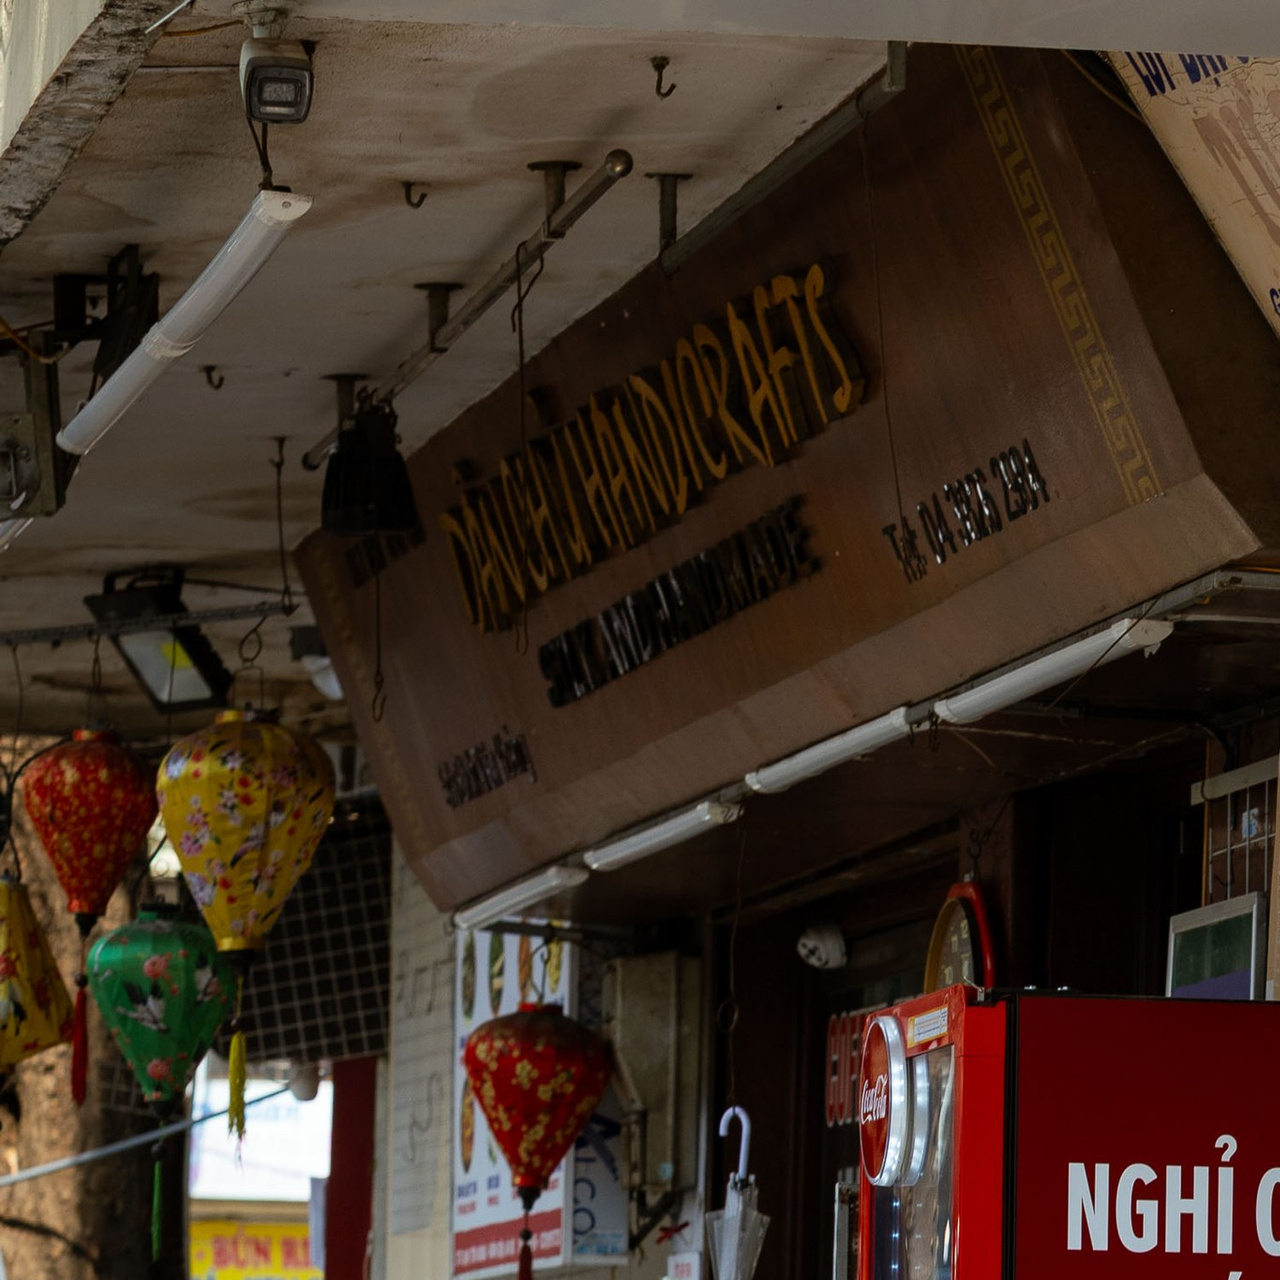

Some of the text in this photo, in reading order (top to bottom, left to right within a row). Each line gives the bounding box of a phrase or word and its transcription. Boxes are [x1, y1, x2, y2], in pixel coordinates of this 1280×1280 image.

[563, 263, 868, 556] HANDICRAFTS
[917, 491, 958, 564] 04
[1067, 1134, 1238, 1255] NGHỈ
